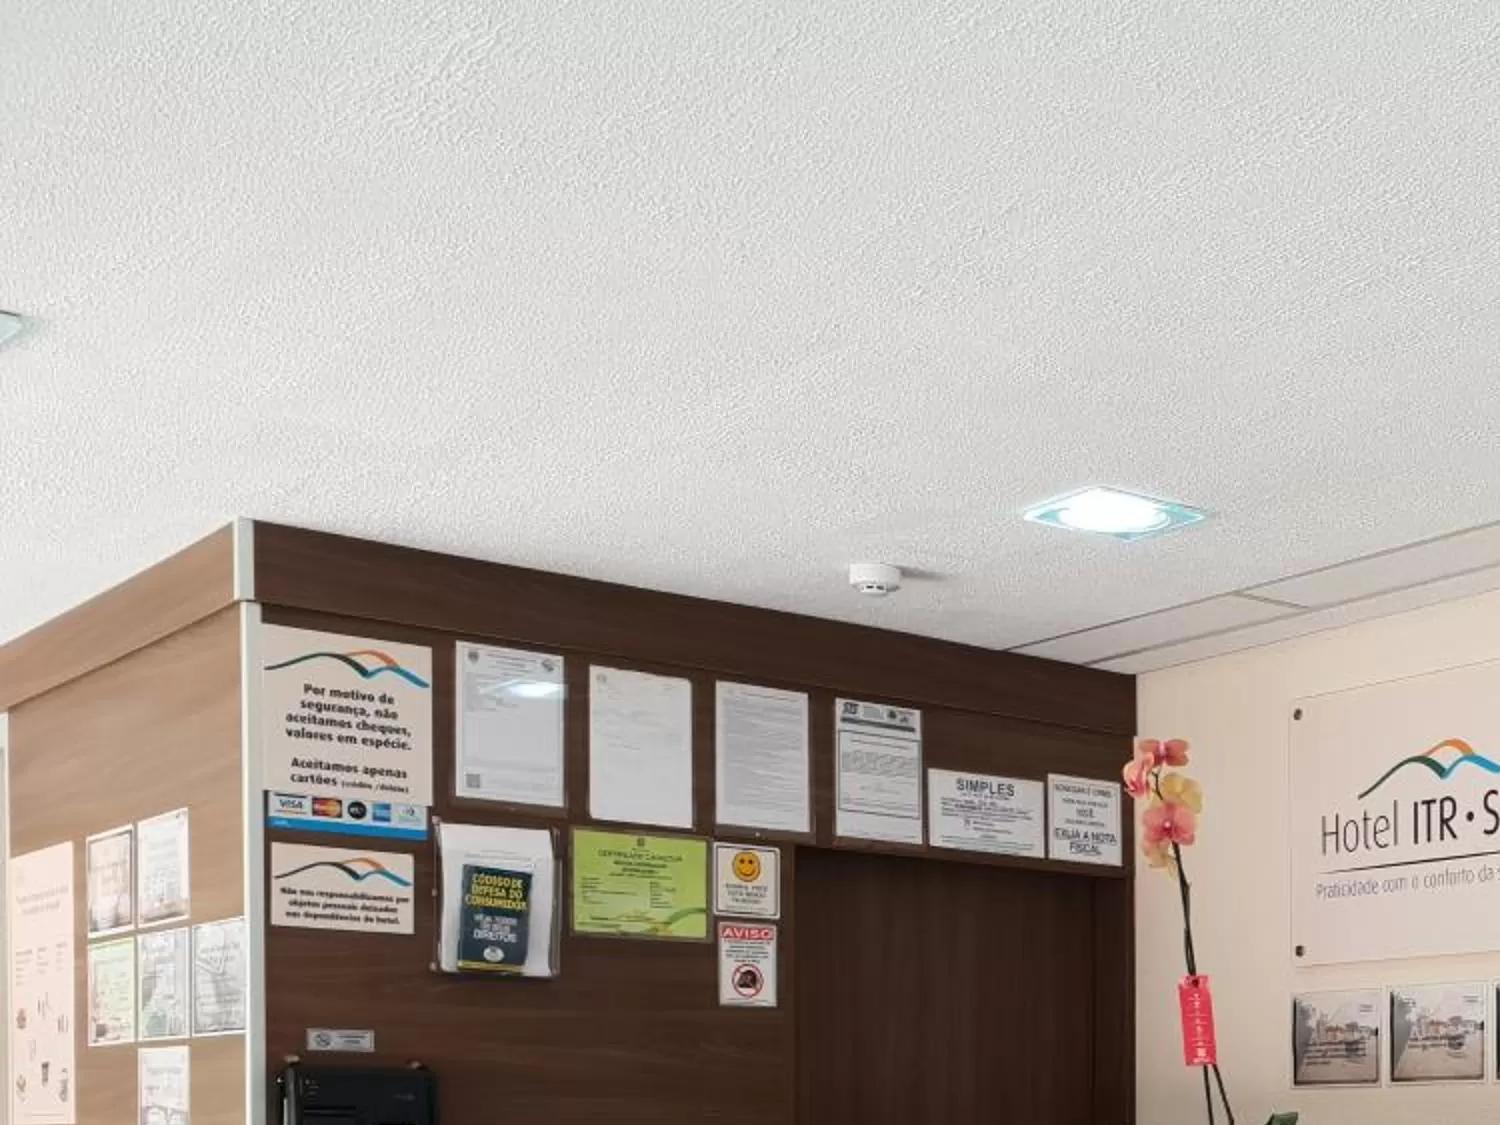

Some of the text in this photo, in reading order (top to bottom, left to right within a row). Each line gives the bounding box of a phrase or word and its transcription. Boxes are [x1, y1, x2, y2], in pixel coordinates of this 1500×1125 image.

[303, 683, 395, 705] Por motivo de
[300, 699, 399, 720] segurança, não
[285, 713, 412, 738] aceitamos cheques,
[285, 727, 413, 751] valores em espécie.
[290, 773, 338, 786] cartões
[291, 757, 408, 780] Aceitamos apenas
[956, 777, 1016, 797] SIMPLES
[1320, 800, 1399, 857] Hotel
[1413, 795, 1458, 845] ITR
[1315, 878, 1379, 900] Praticidade
[1383, 876, 1408, 894] com
[1423, 867, 1476, 889] conforto
[1478, 863, 1496, 882] da
[723, 927, 773, 940] AVISO
